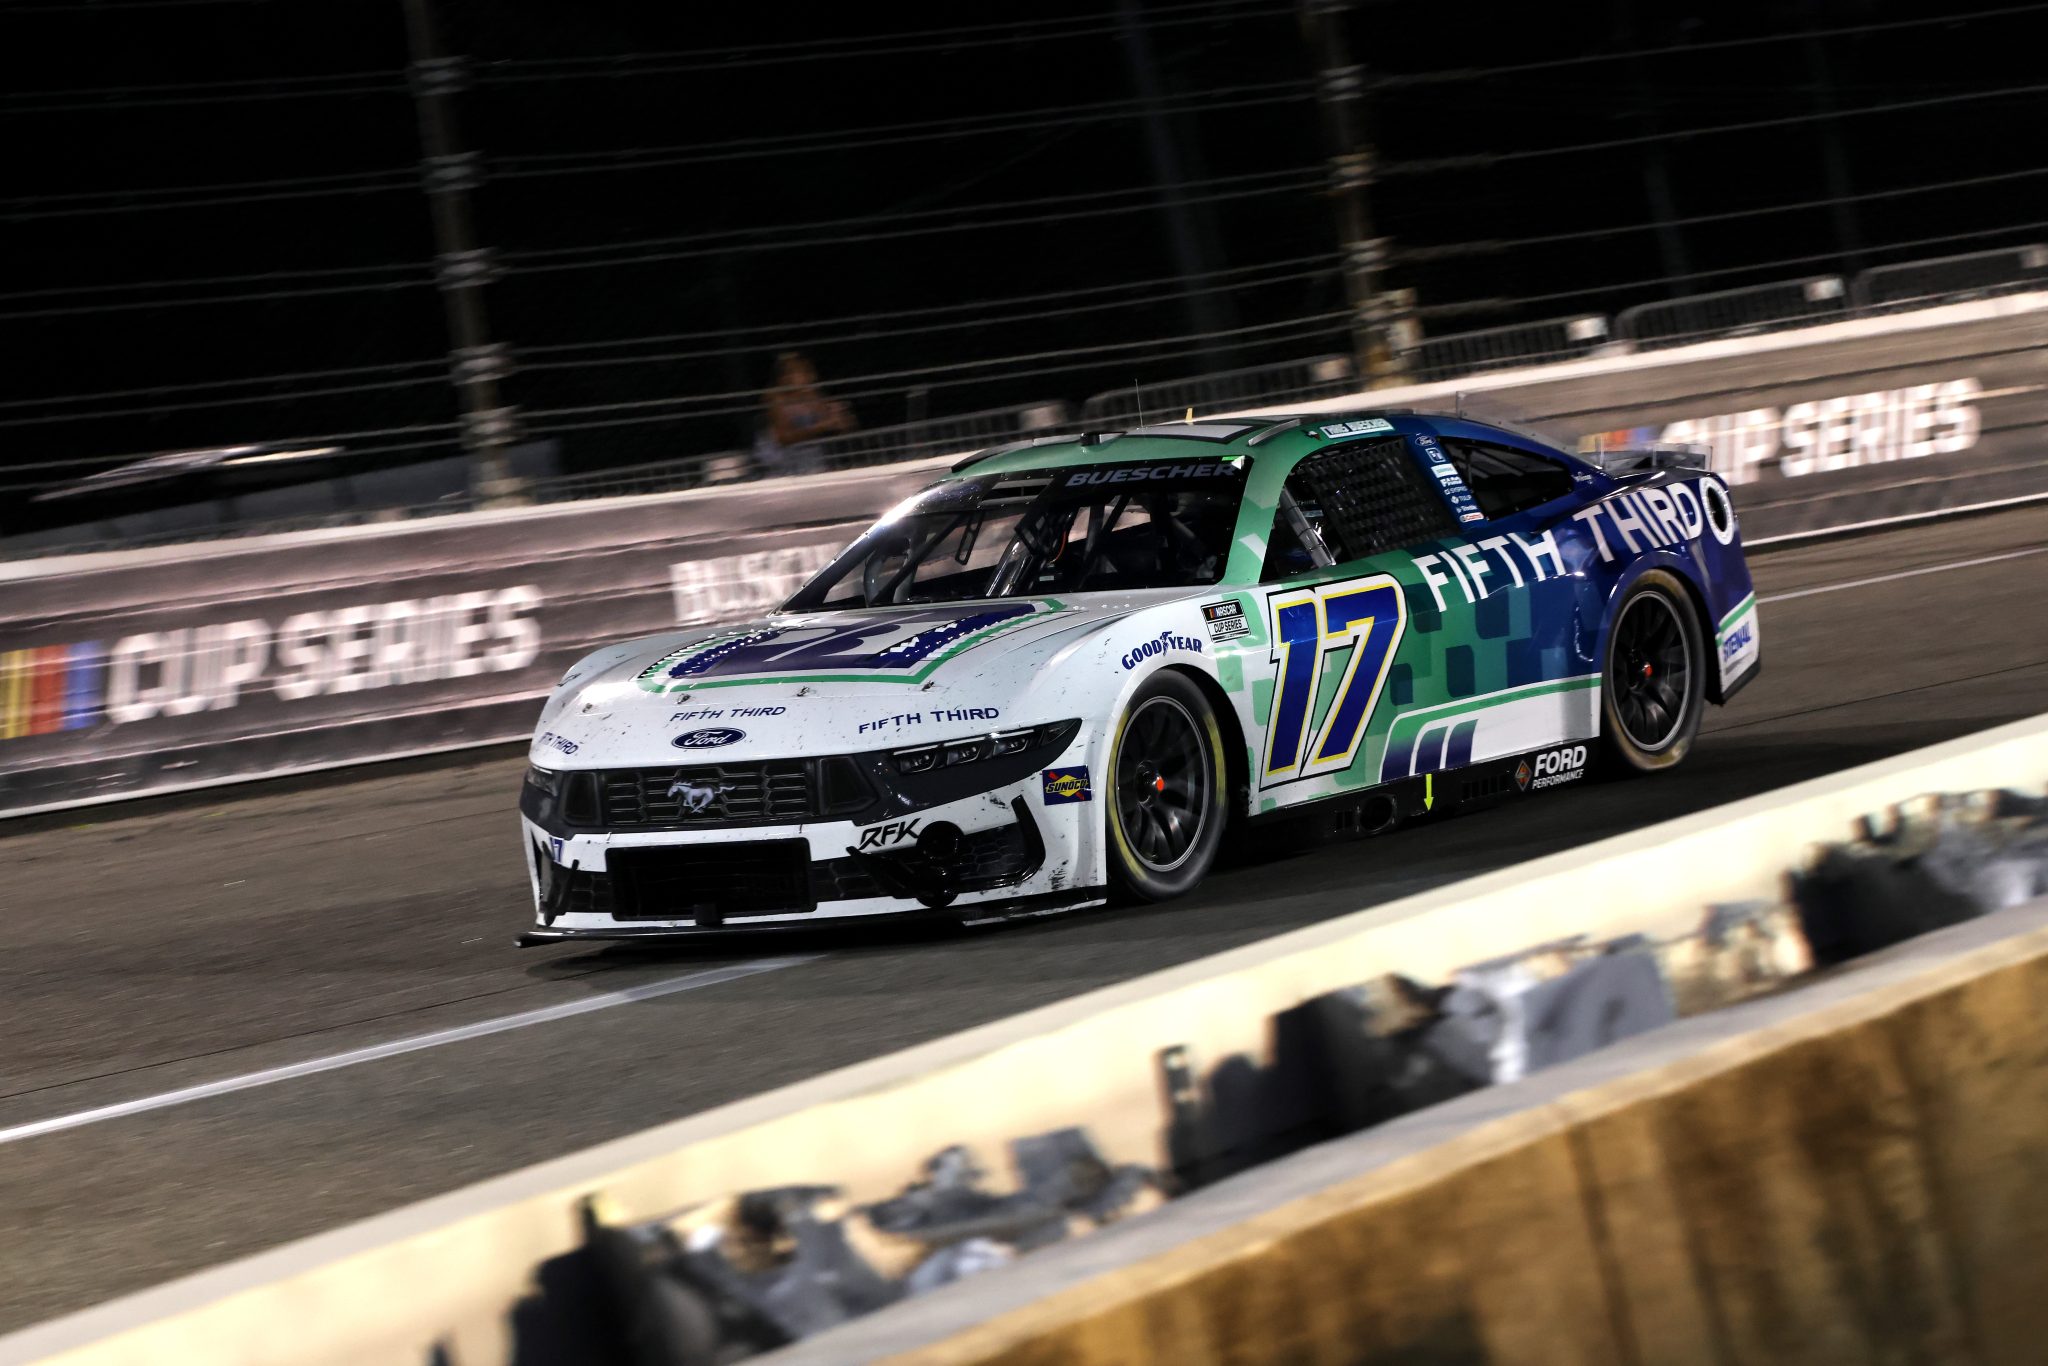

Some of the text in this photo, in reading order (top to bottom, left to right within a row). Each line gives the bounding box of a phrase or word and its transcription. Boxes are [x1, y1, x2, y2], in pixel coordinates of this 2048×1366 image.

[1780, 376, 1983, 478] SERIES
[1065, 463, 1236, 487] BUESCHER
[1411, 482, 1703, 613] FIFTH THIRD
[1213, 619, 1242, 633] CUP SERIES
[106, 584, 542, 724] CUP SERIES
[1260, 572, 1407, 791] 17
[669, 706, 787, 722] FIFTH THIRD
[858, 706, 1000, 735] FIFTH THIRD
[685, 730, 731, 747] Ford
[1533, 745, 1588, 778] FORD
[1046, 778, 1088, 794] SUNOCO
[1531, 768, 1585, 790] PERFORMANCE
[858, 817, 922, 851] RFK
